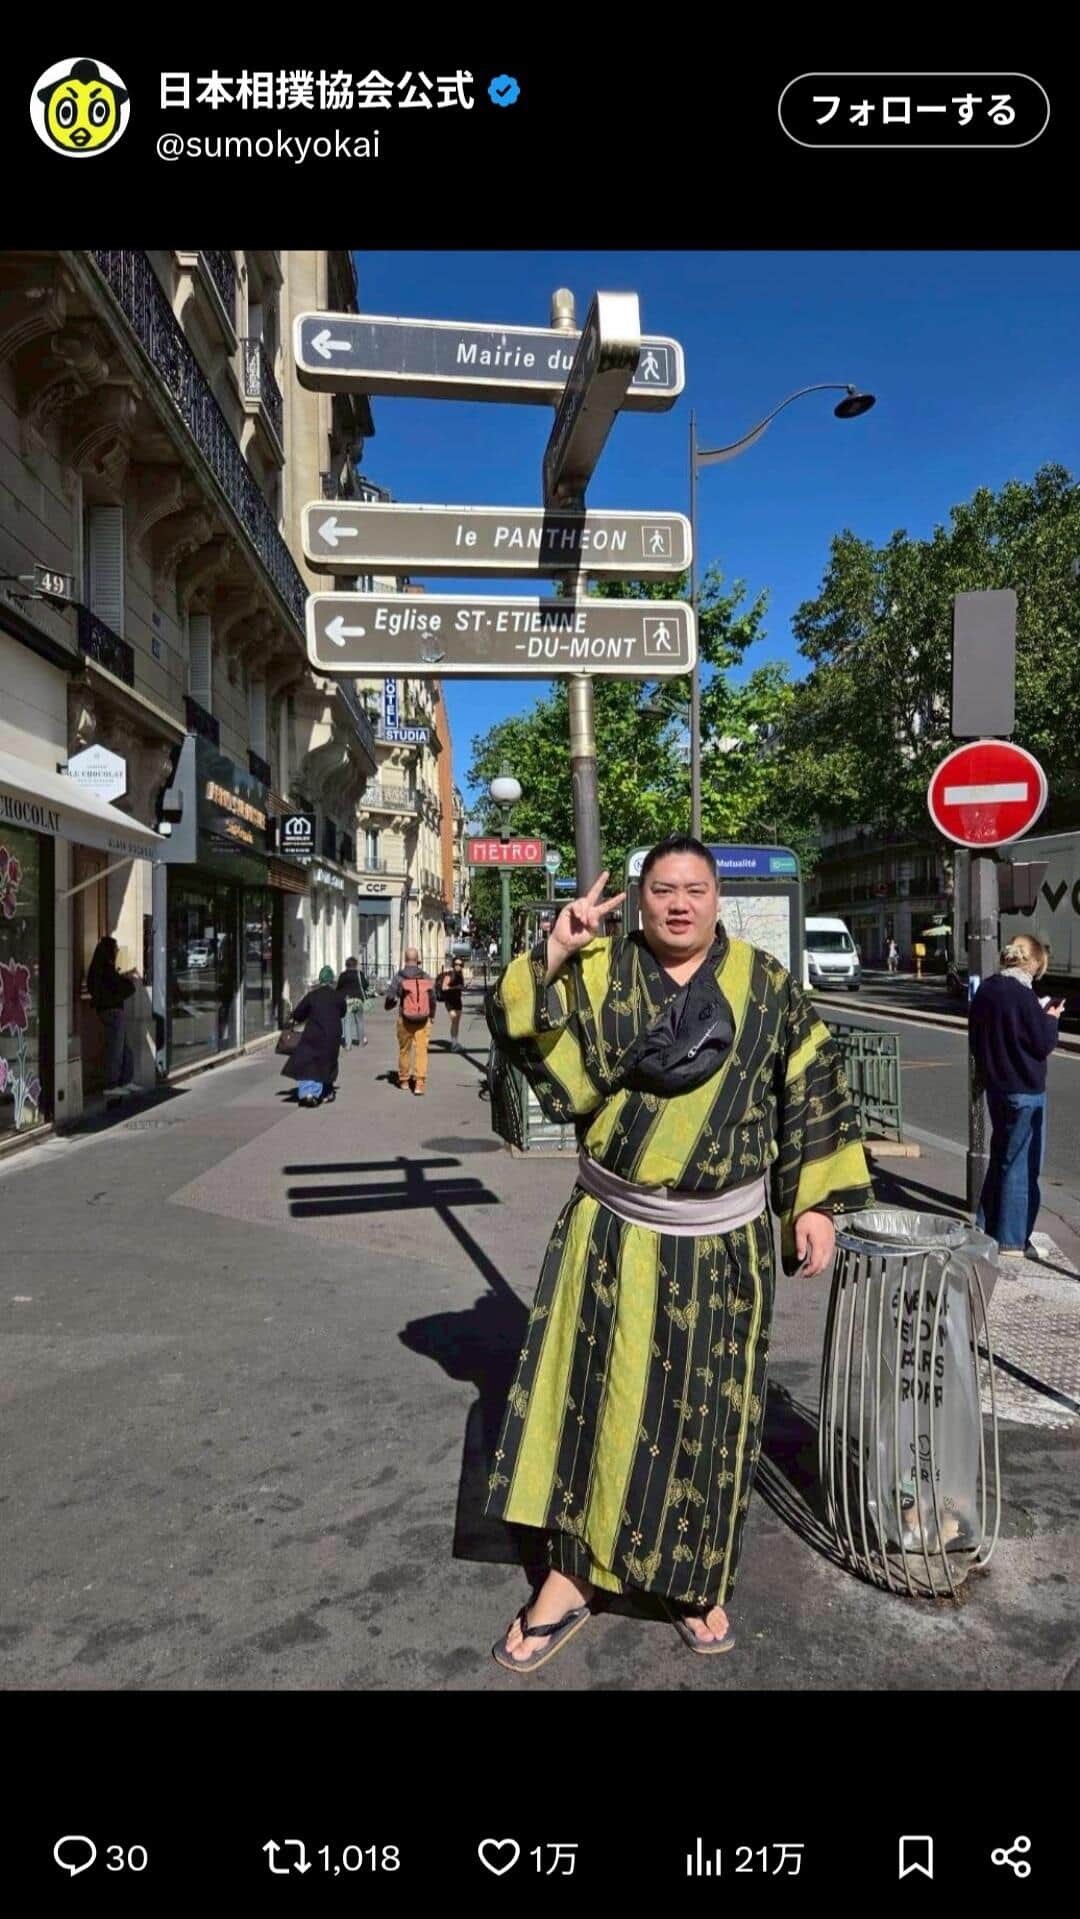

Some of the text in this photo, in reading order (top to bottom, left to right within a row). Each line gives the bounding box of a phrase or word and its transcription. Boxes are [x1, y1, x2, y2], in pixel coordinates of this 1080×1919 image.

[456, 343, 574, 370] Mairie du
[456, 525, 627, 550] le PANTHEON
[42, 573, 64, 594] 49
[375, 608, 442, 636] Eglise
[386, 730, 426, 741] STUDIA
[473, 843, 538, 860] METRO
[366, 883, 387, 893] CCF
